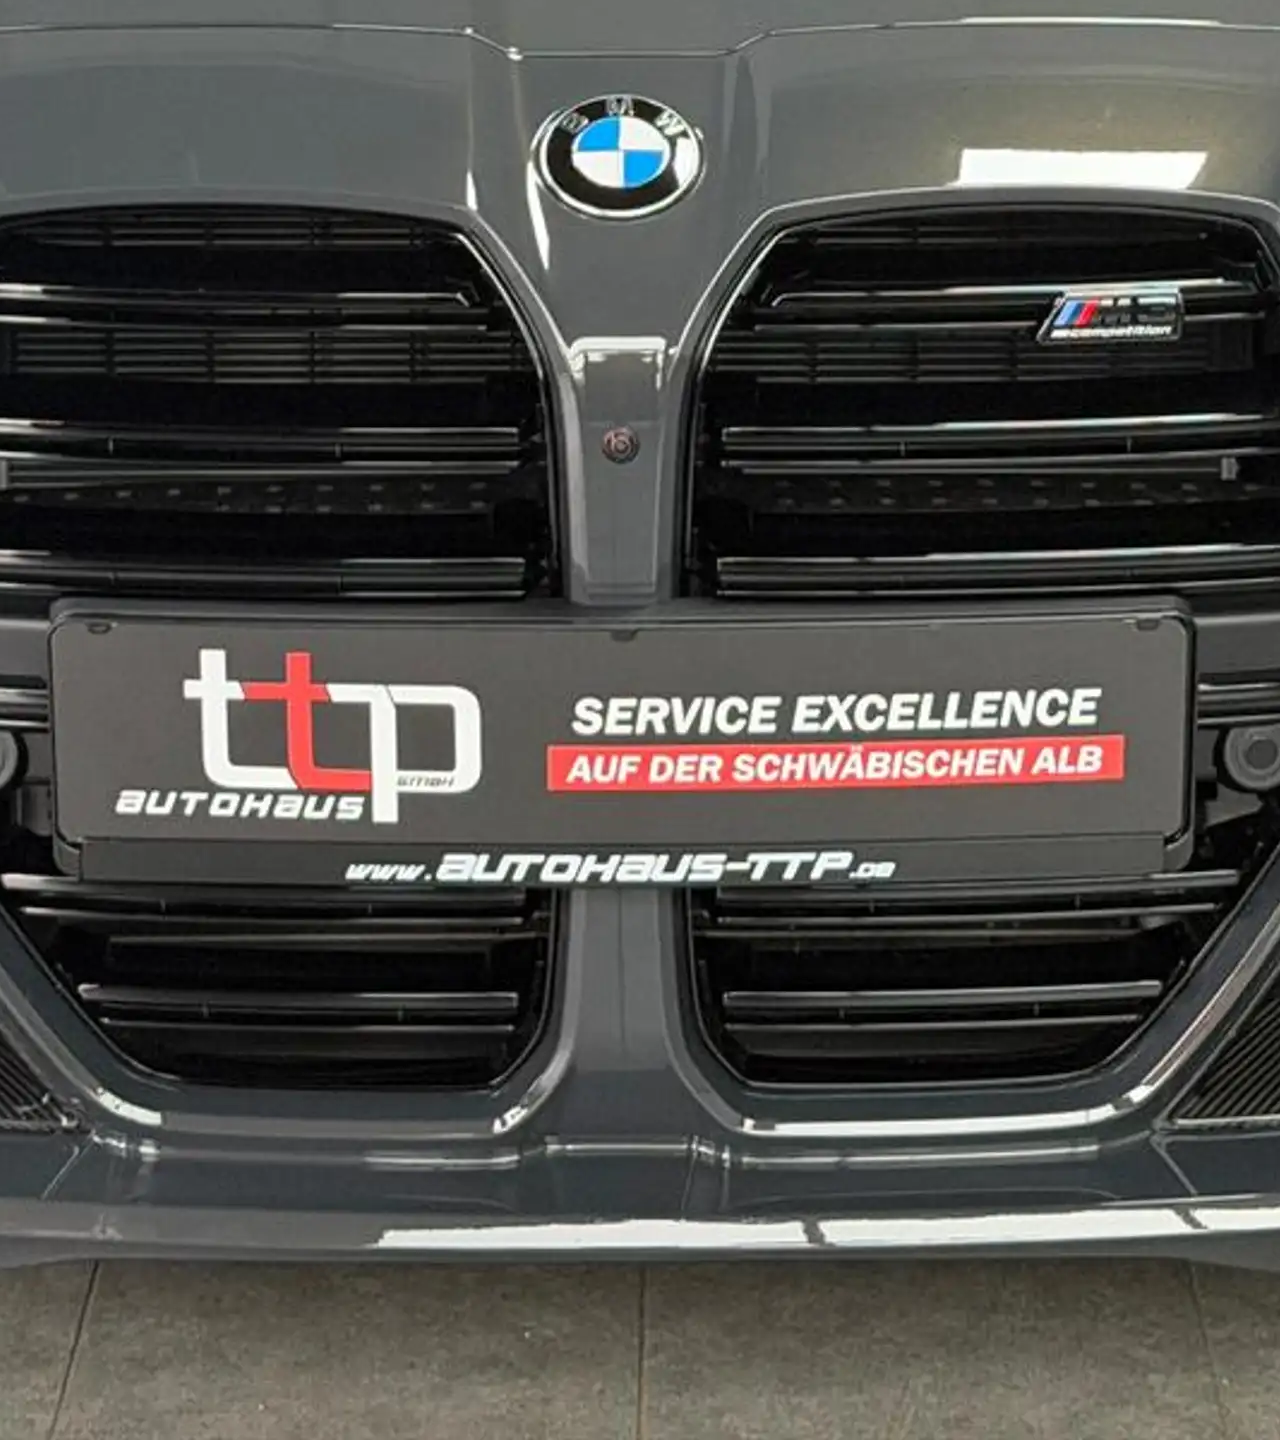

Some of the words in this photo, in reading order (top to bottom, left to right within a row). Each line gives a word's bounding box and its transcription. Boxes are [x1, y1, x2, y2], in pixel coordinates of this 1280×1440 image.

[560, 95, 685, 137] BMW
[571, 696, 782, 736] SERVICE
[791, 688, 1103, 734] EXCELLENCE
[183, 648, 483, 824] ttp
[566, 754, 641, 784] AUF
[647, 754, 722, 784] DER
[731, 745, 1023, 782] SCHWÄBISCHEN
[1031, 746, 1104, 775] ALB
